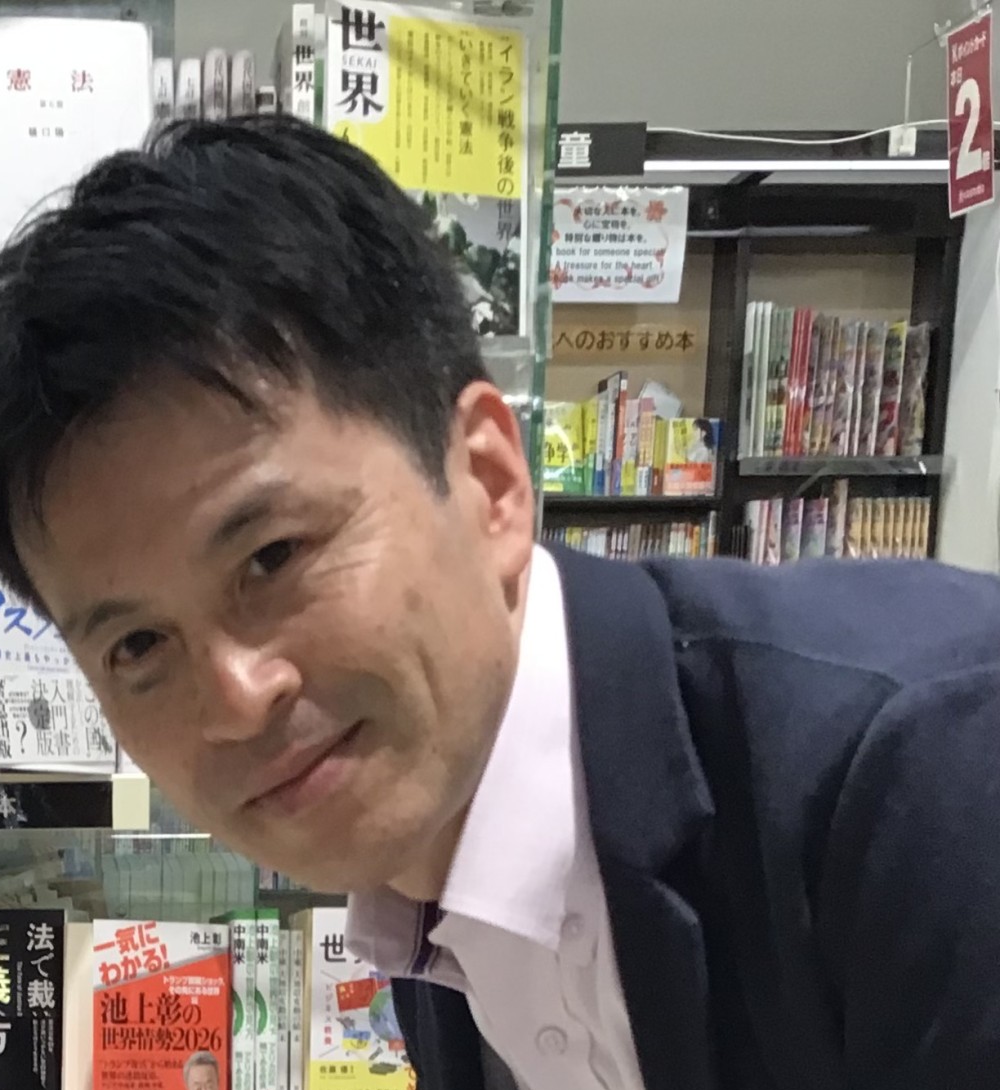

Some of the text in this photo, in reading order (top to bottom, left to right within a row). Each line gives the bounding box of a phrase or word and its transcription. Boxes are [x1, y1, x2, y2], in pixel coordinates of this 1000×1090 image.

[294, 44, 314, 92] 世界
[332, 6, 386, 116] 世界
[6, 69, 94, 93] 憲法
[955, 79, 982, 180] 2
[93, 922, 159, 952] 一気に
[190, 932, 222, 946] 池上彰
[233, 924, 246, 964] 中南米
[256, 924, 269, 964] 中南米
[101, 992, 201, 1025] 池上彰の
[102, 1028, 222, 1051] 世界情勢2026
